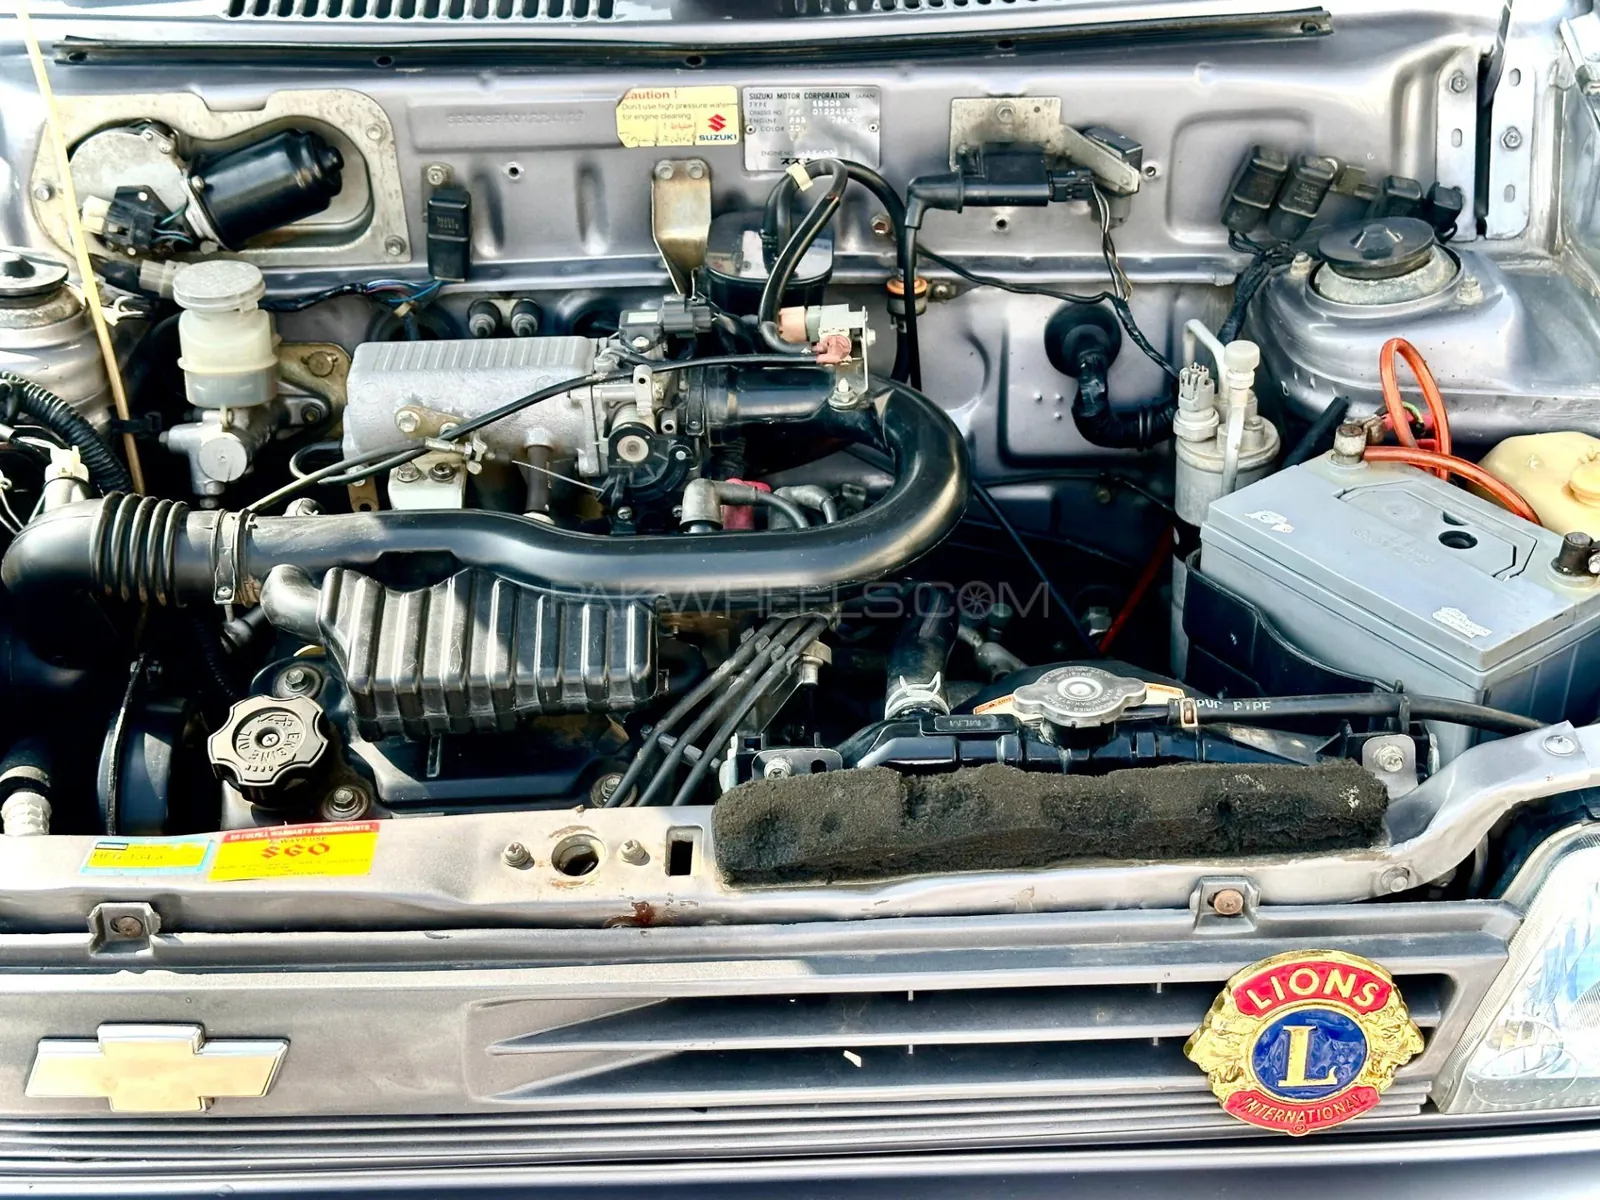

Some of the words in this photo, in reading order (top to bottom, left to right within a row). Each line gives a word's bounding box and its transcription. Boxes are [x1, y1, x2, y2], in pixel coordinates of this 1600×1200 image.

[749, 92, 773, 100] SUZUKI
[777, 92, 800, 100] MOTOR
[658, 103, 674, 111] high
[660, 113, 692, 121] cleaning
[698, 133, 737, 142] SUZUKI
[271, 828, 313, 837] WARRANTY
[314, 824, 371, 834] REQUIREMENTS
[260, 842, 331, 860] SGO
[1247, 968, 1380, 1011] LIONS
[1277, 1025, 1338, 1087] L
[1239, 1094, 1366, 1125] INTERNATIONAL
